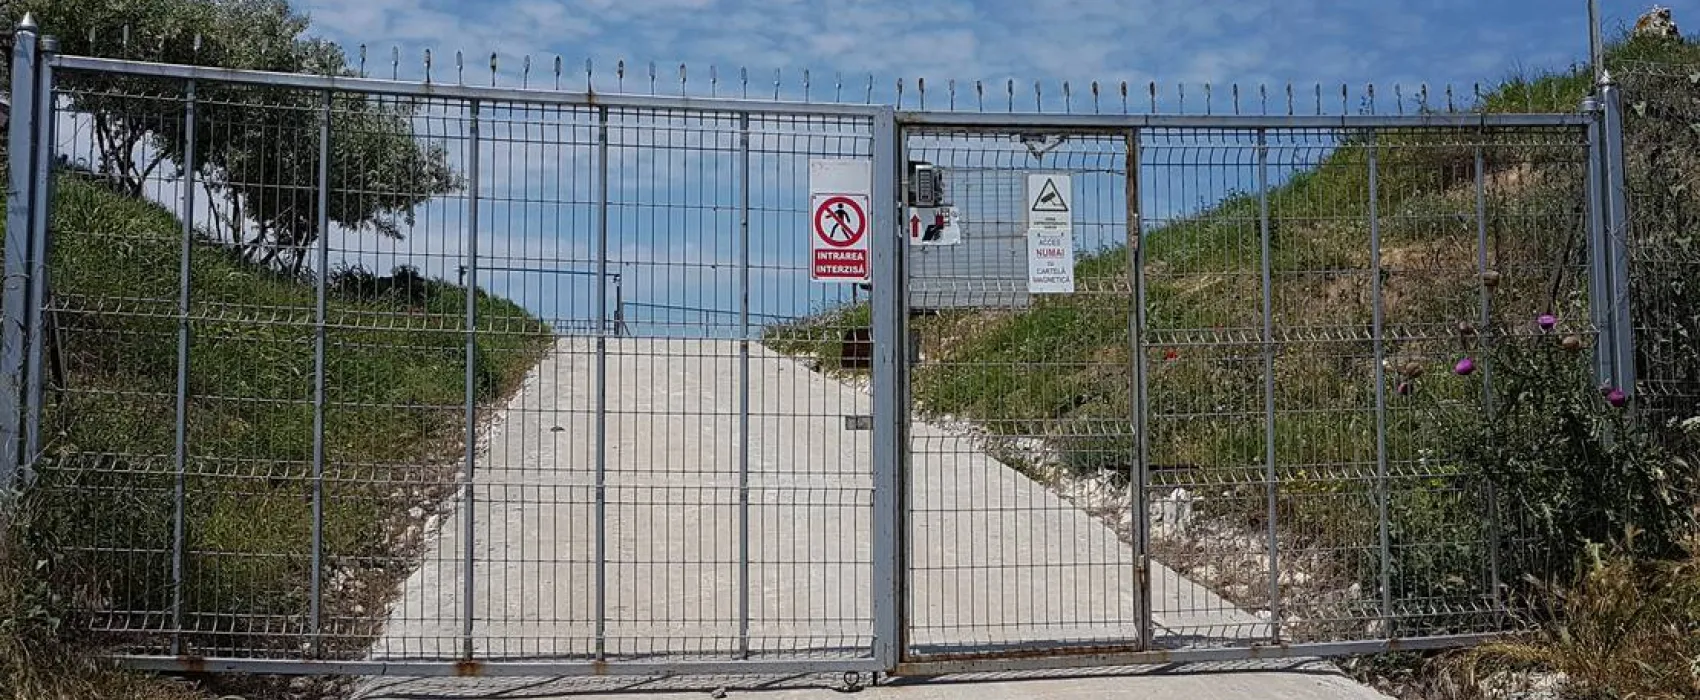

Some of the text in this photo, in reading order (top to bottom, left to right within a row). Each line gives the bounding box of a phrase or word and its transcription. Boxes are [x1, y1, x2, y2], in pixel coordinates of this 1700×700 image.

[817, 252, 864, 261] INTRAREA
[1036, 249, 1065, 258] NUMAI
[816, 264, 864, 274] INTERZISĂ
